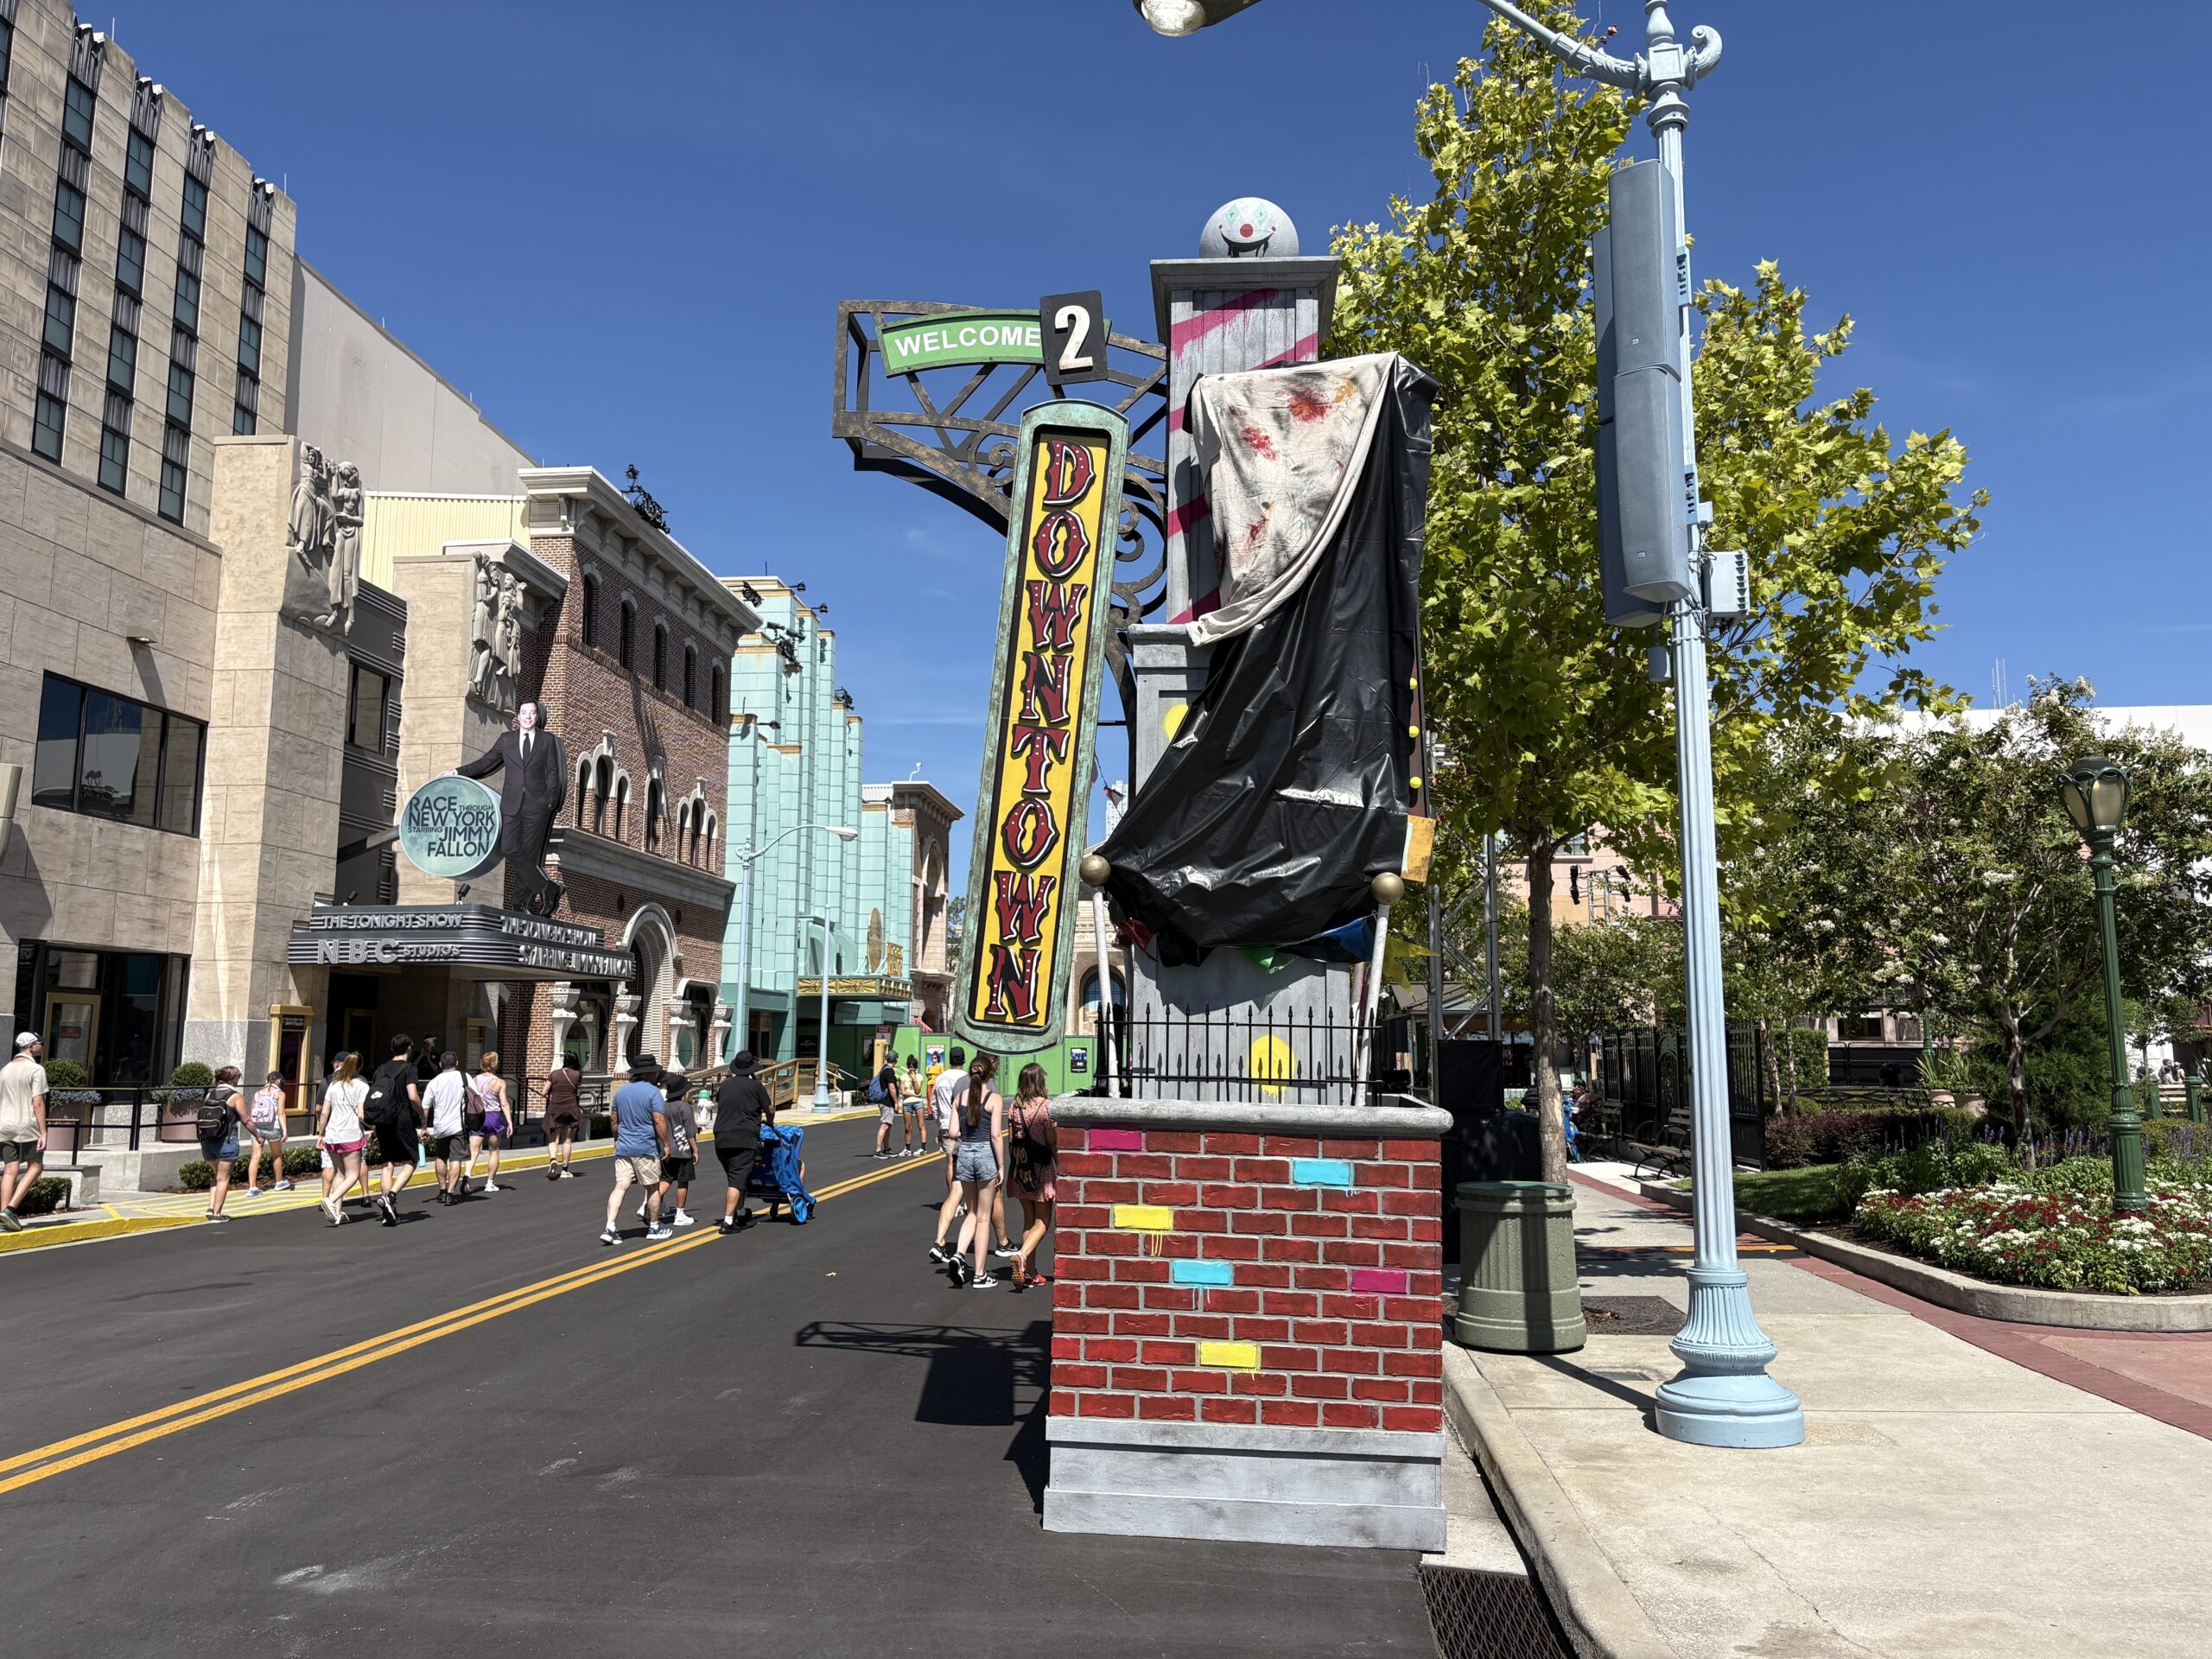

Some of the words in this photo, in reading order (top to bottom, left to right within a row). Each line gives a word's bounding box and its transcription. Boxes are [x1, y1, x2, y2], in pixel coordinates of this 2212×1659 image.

[894, 326, 1041, 357] WELCOME
[1054, 305, 1094, 372] 2
[985, 440, 1096, 1021] DOWNTOWN
[409, 797, 457, 812] RACE
[408, 811, 448, 827] NEW
[453, 811, 495, 827] YORK
[439, 826, 494, 842] JIMMY
[428, 842, 490, 857] FALLON
[322, 915, 348, 929] THE
[350, 914, 415, 929] TONIGHT
[416, 913, 463, 928] SHOW
[317, 938, 399, 964] NBC
[404, 944, 461, 957] STUDIOS
